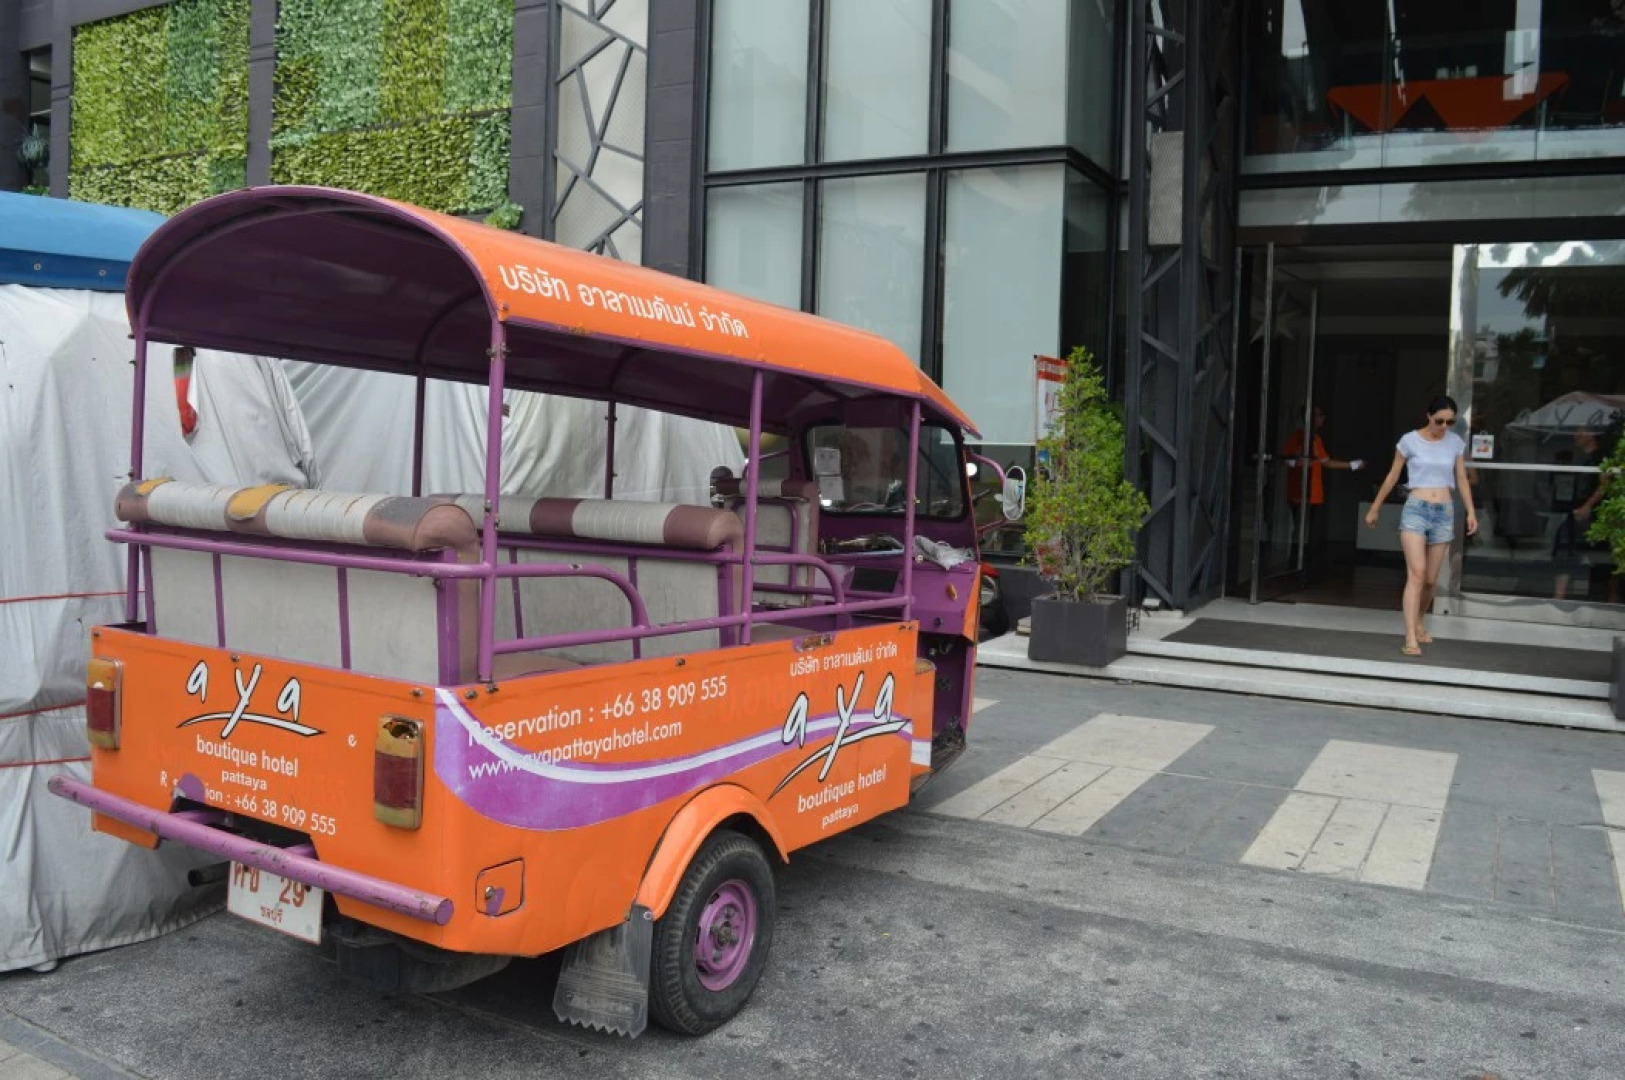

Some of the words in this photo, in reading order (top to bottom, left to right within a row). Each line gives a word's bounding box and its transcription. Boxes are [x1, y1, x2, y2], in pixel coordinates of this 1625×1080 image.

[497, 263, 570, 302] บริษัท
[699, 306, 749, 339] จำกัด
[185, 659, 302, 739] aya
[468, 704, 581, 747] Reservation
[601, 694, 635, 720] +66
[641, 690, 662, 713] 38
[668, 682, 696, 708] 909
[701, 675, 728, 701] 555
[781, 670, 896, 783] aya
[196, 733, 258, 768] boutique
[261, 749, 299, 777] hotel
[468, 719, 682, 780] www.apattayahotel.com
[221, 770, 268, 791] pattaya
[798, 778, 855, 813] boutique
[857, 763, 887, 791] hotel
[234, 794, 258, 813] +66
[261, 798, 278, 819] 38
[282, 804, 307, 827] 909
[311, 813, 337, 836] 555
[821, 801, 860, 830] pattaya
